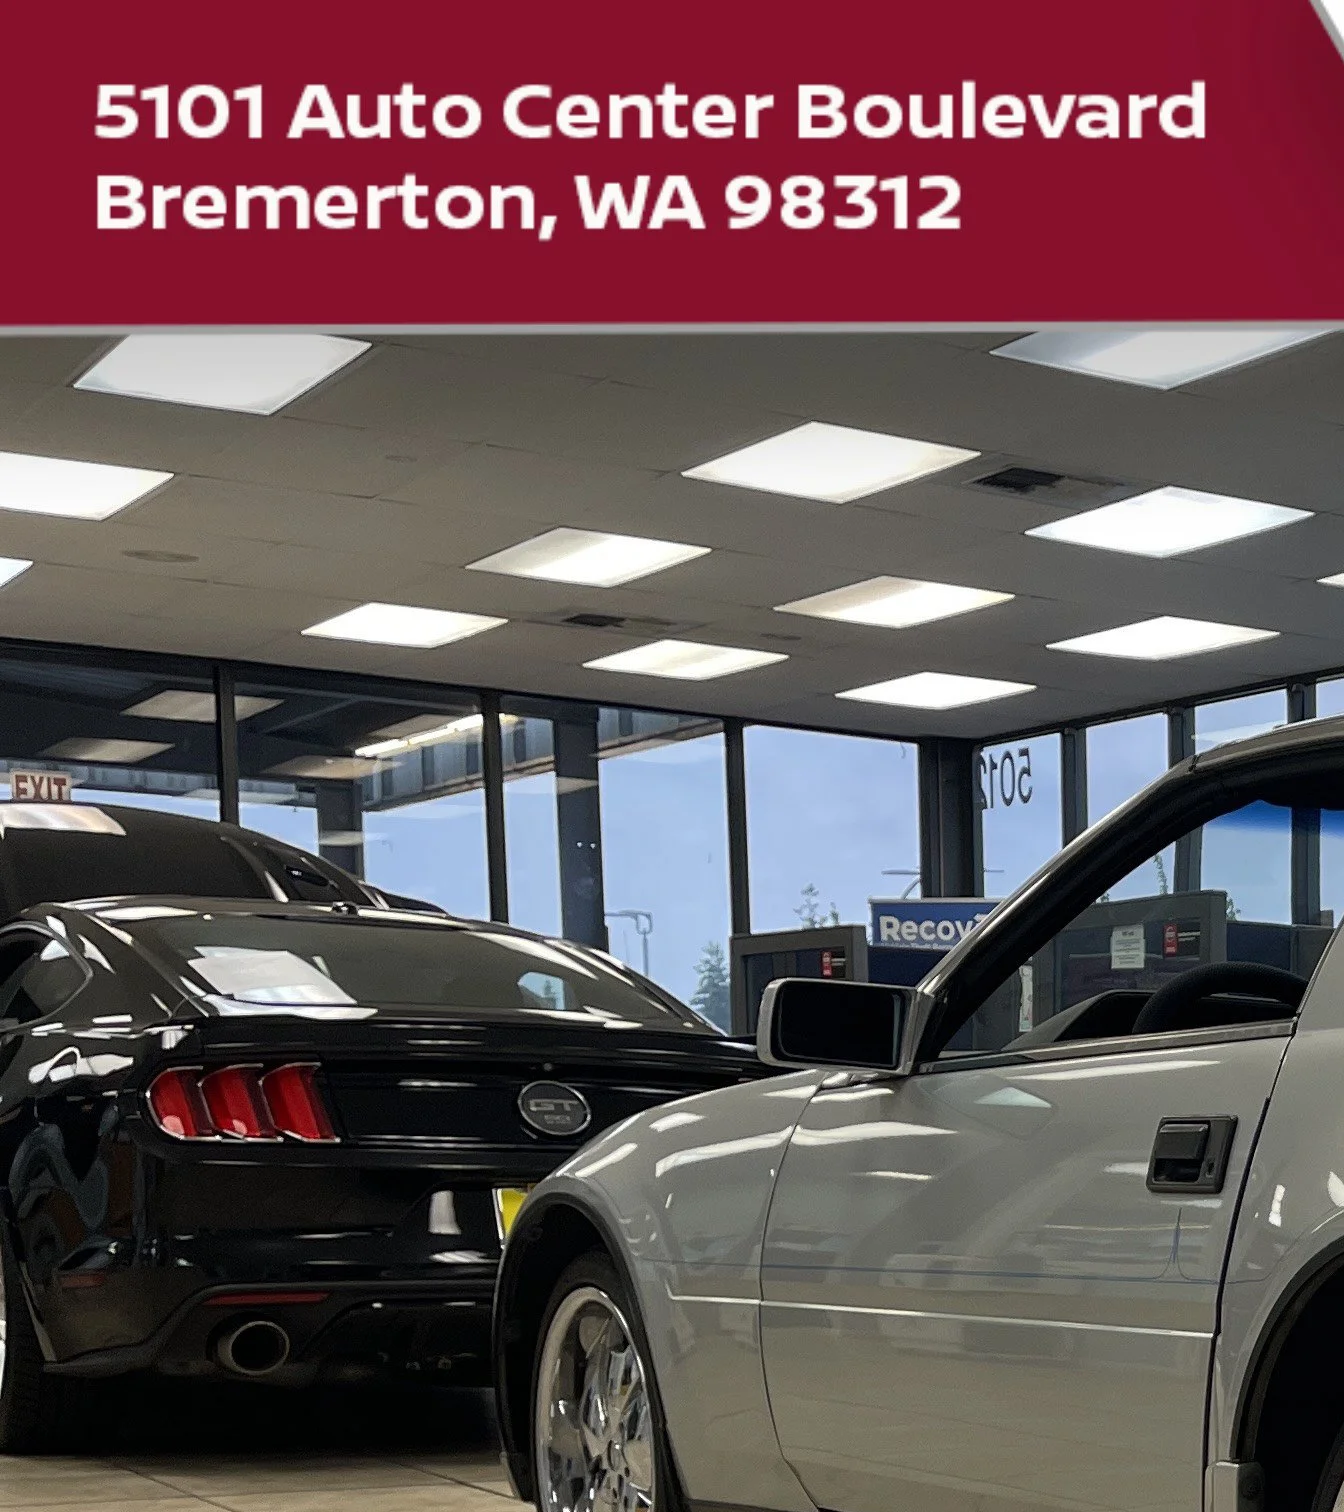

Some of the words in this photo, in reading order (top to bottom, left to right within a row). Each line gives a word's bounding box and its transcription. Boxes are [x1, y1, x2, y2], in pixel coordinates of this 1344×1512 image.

[15, 774, 67, 801] EXIT
[880, 914, 986, 941] Recov
[529, 1099, 579, 1112] GT
